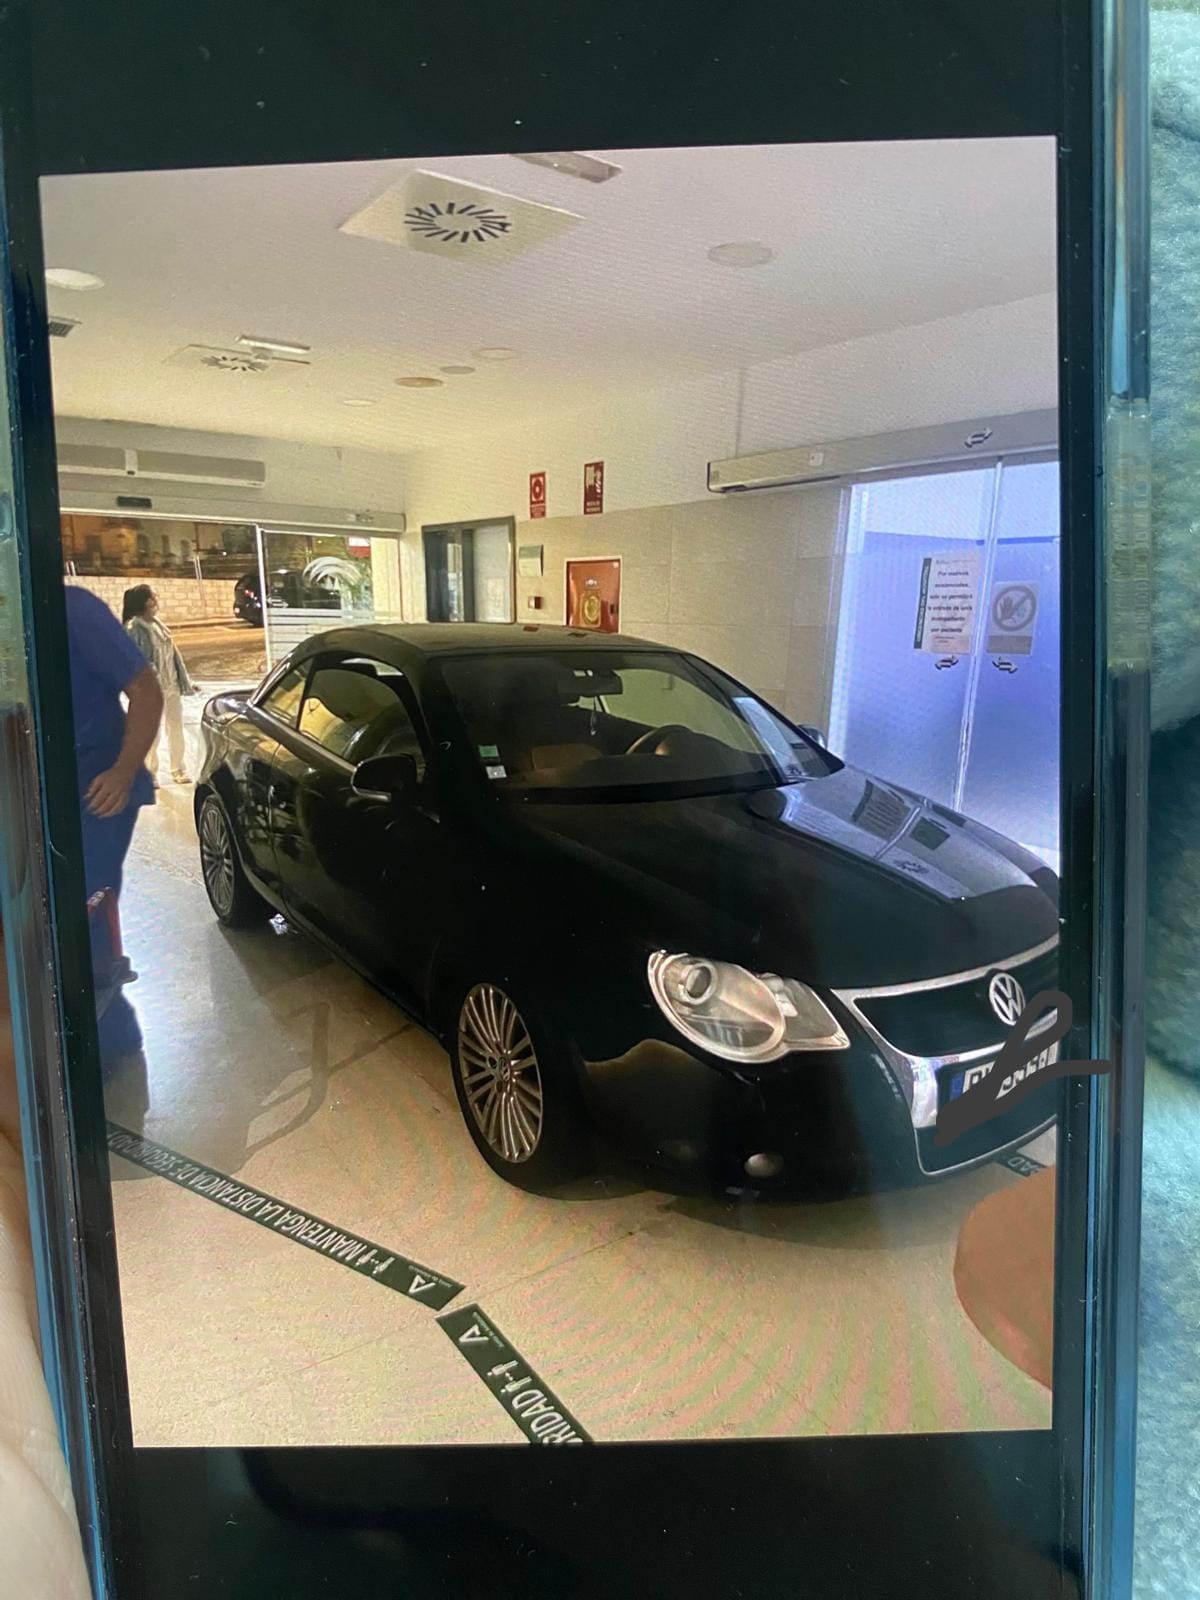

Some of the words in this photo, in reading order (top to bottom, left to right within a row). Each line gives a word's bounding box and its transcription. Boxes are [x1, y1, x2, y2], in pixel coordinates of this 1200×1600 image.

[188, 1171, 266, 1212] DISTANCIA
[254, 1201, 285, 1221] LA
[273, 1210, 367, 1261] MANTENGA
